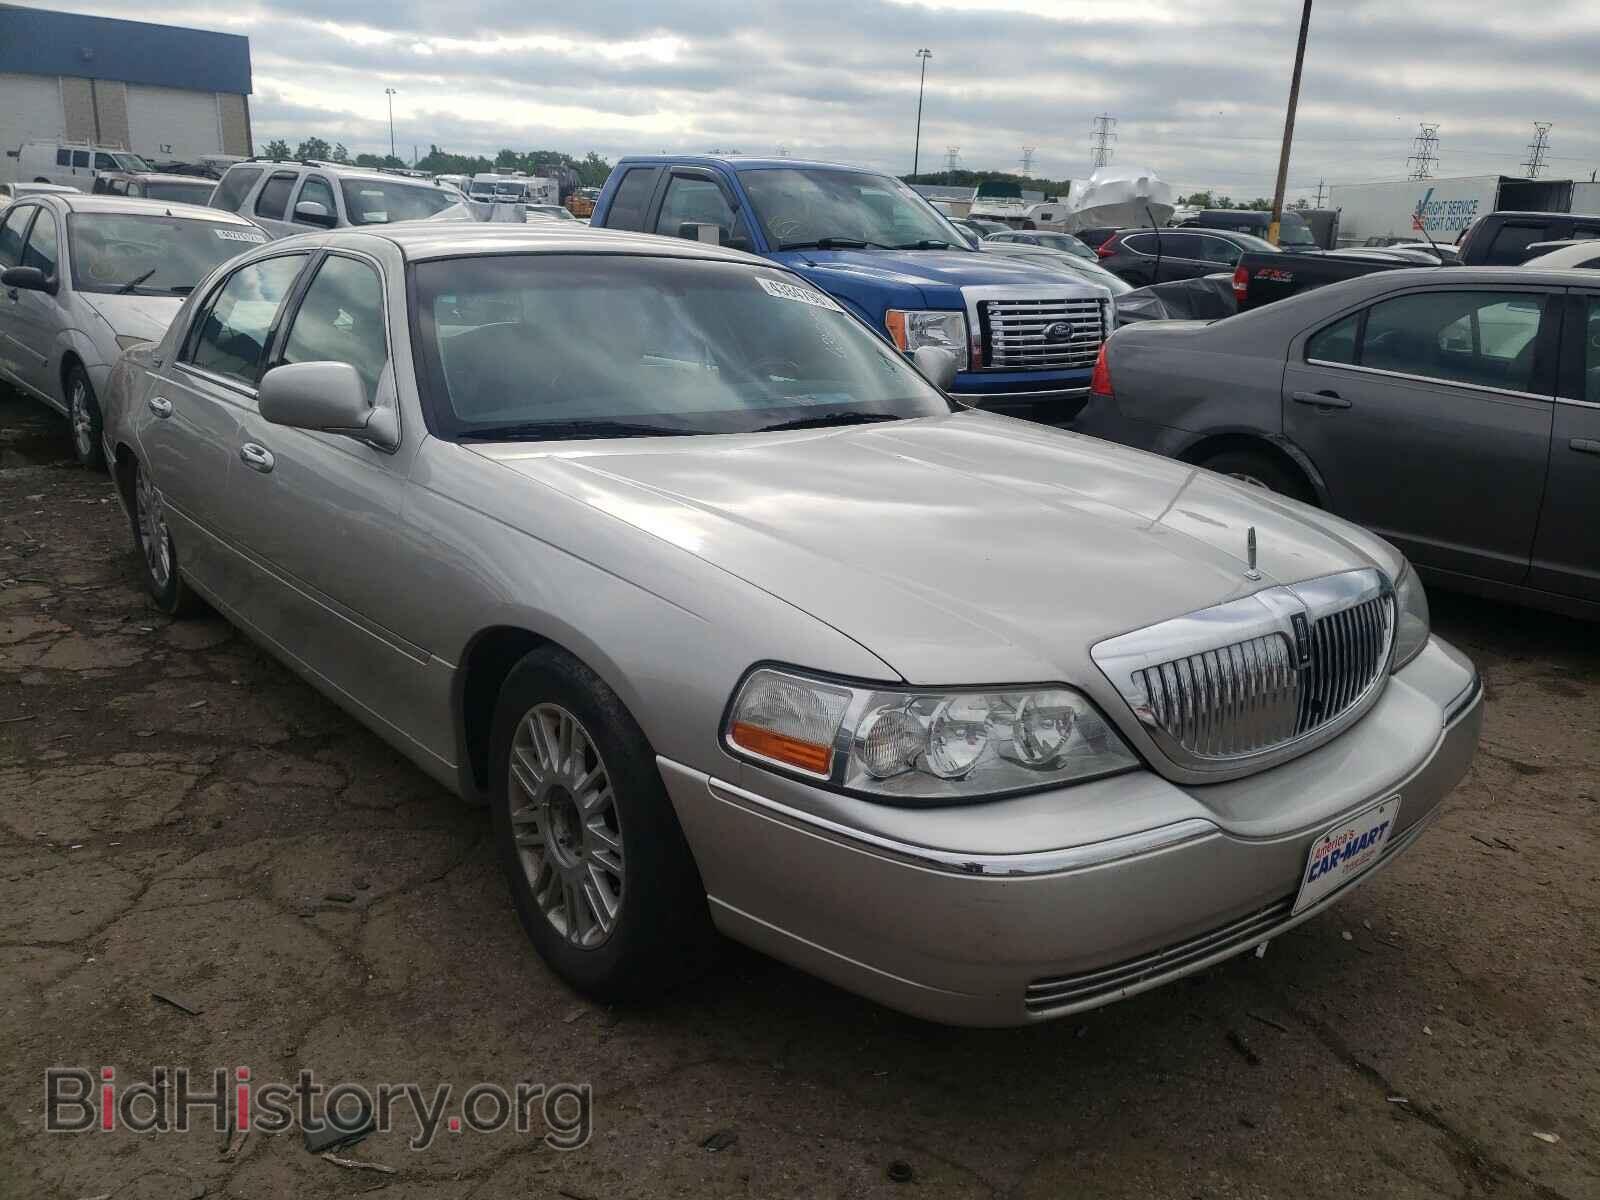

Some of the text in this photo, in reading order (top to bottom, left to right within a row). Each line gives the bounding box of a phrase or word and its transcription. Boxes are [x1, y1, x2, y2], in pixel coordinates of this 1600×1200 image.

[1426, 199, 1479, 215] RIGHT SERVICE
[1424, 216, 1473, 231] RIGHT CHOICE
[1307, 821, 1389, 883] CAR-MART
[1316, 829, 1356, 859] America's
